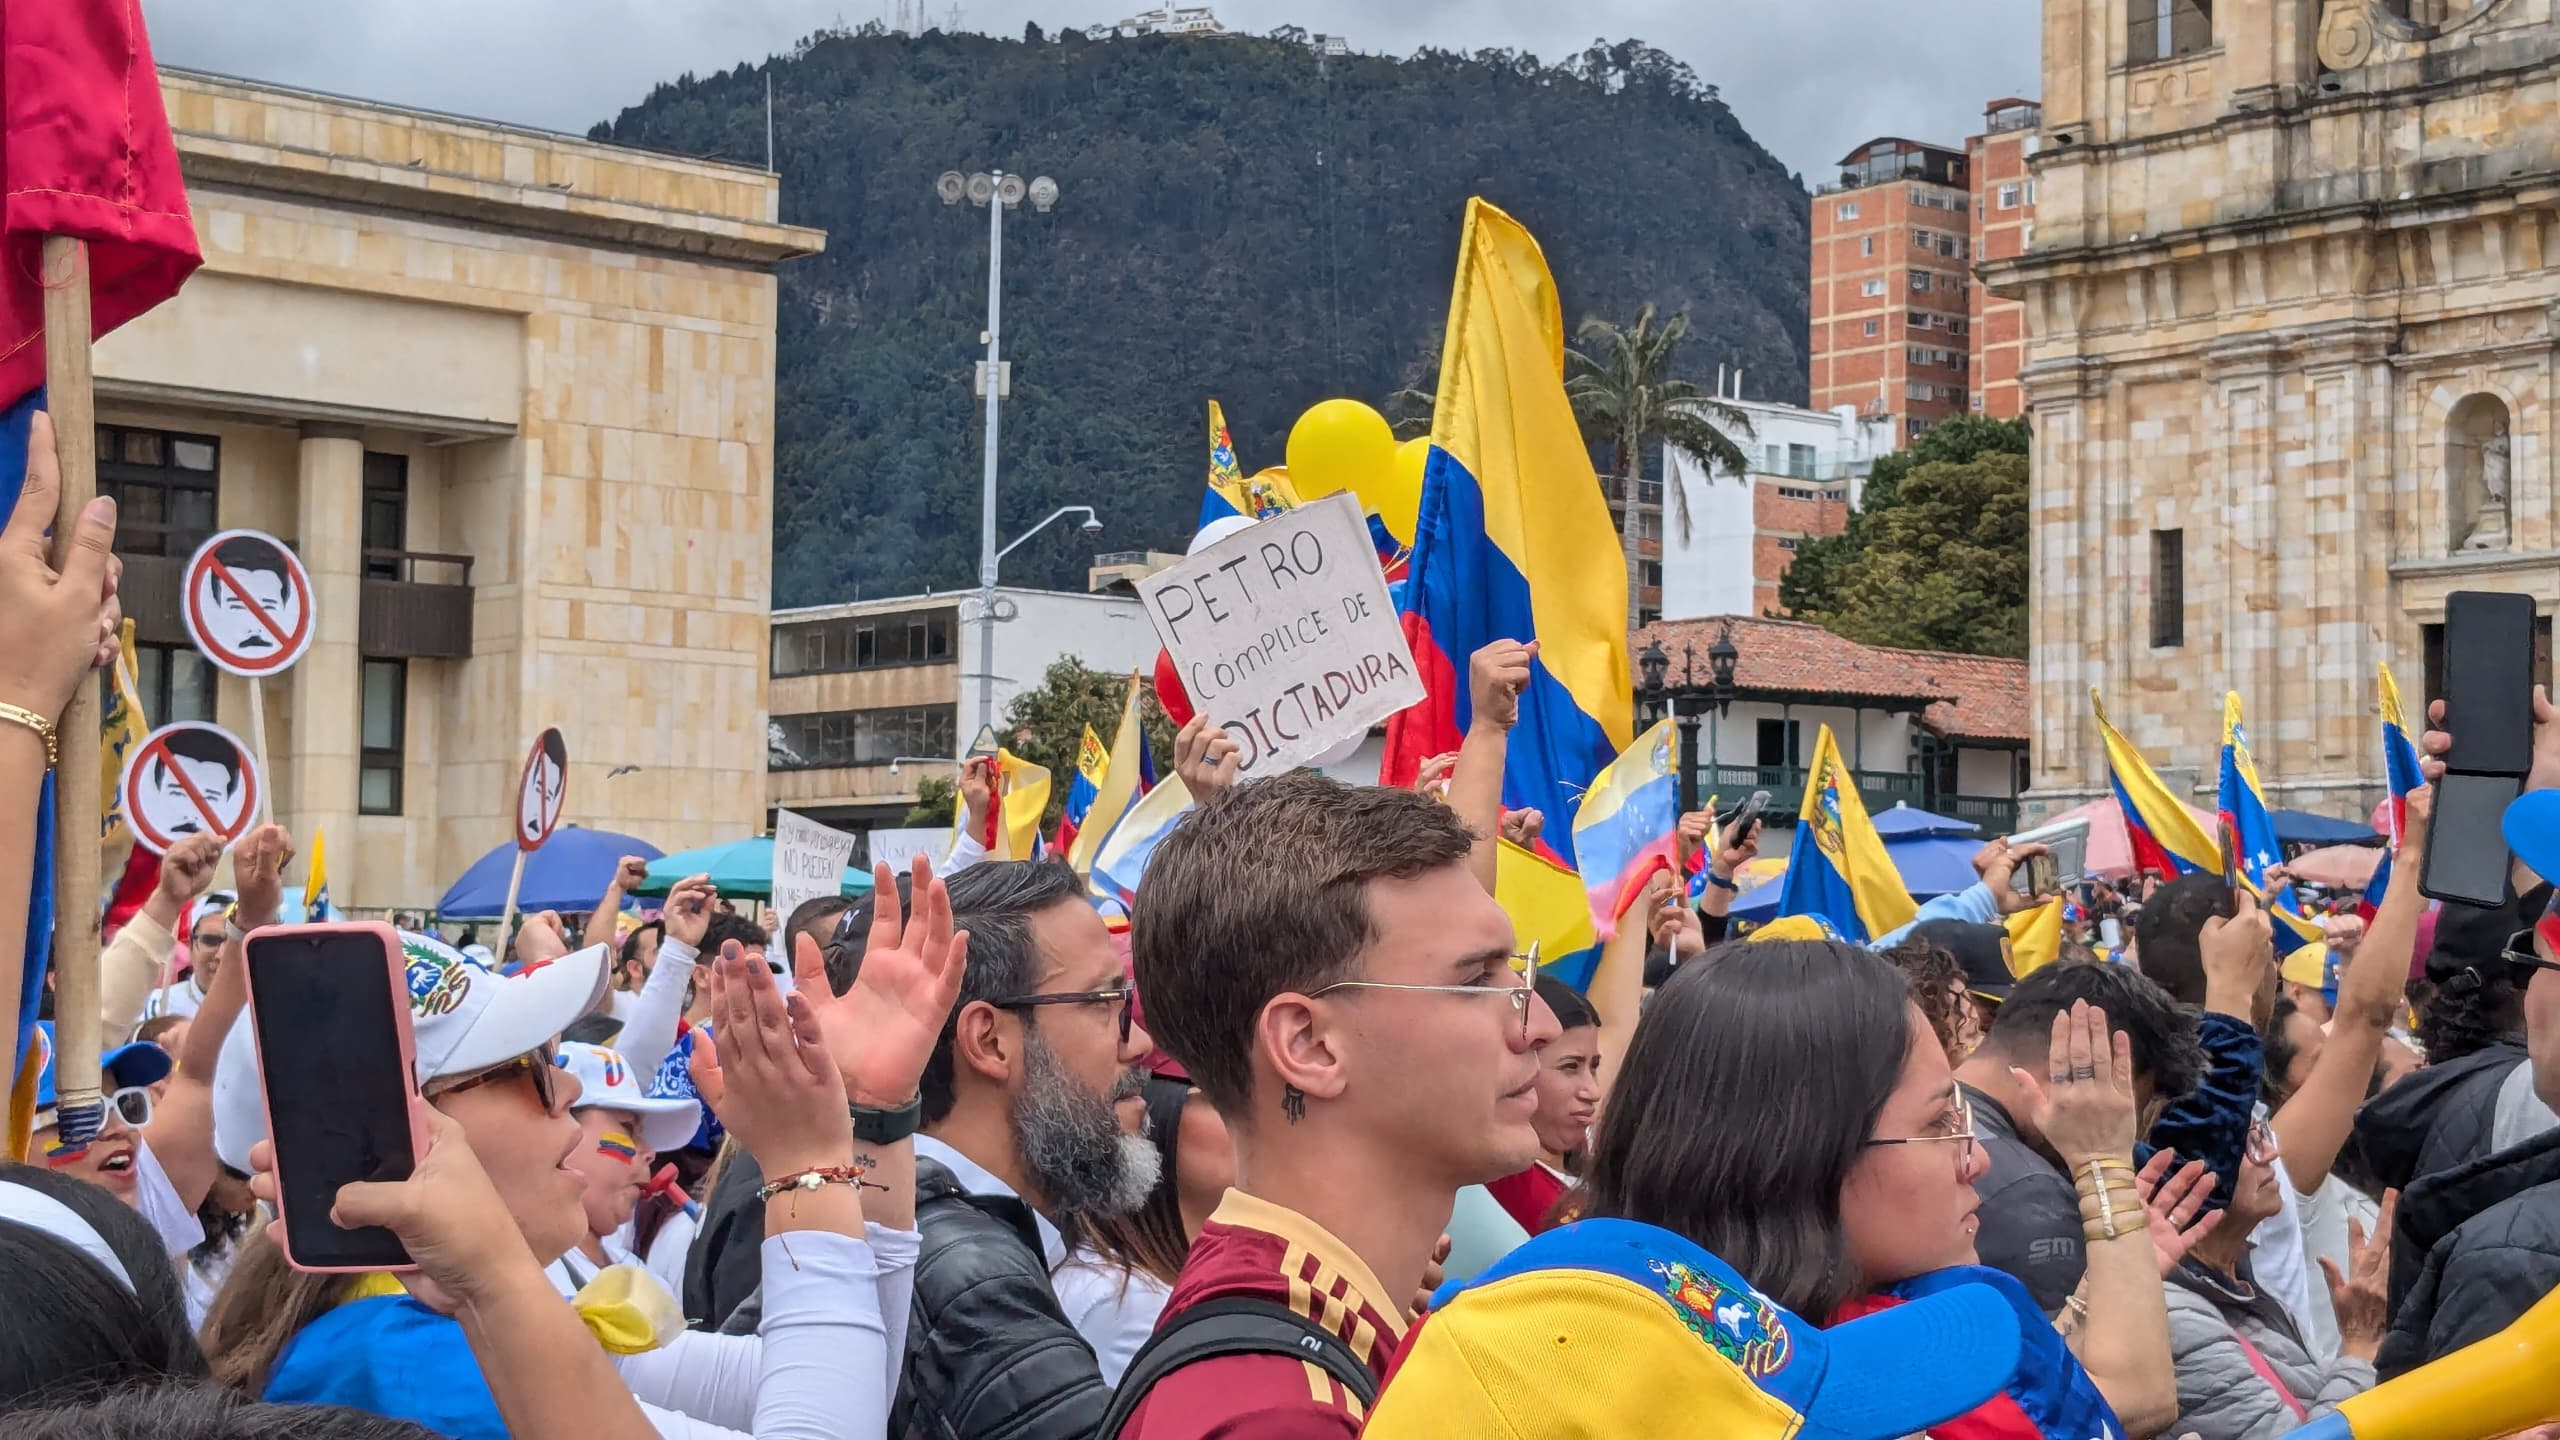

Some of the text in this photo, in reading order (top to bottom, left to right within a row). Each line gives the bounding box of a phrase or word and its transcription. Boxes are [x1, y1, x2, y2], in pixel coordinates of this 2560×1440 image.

[1155, 531, 1323, 645] PETRO
[1342, 593, 1371, 623] DE
[1219, 652, 1409, 771] DICTADURA
